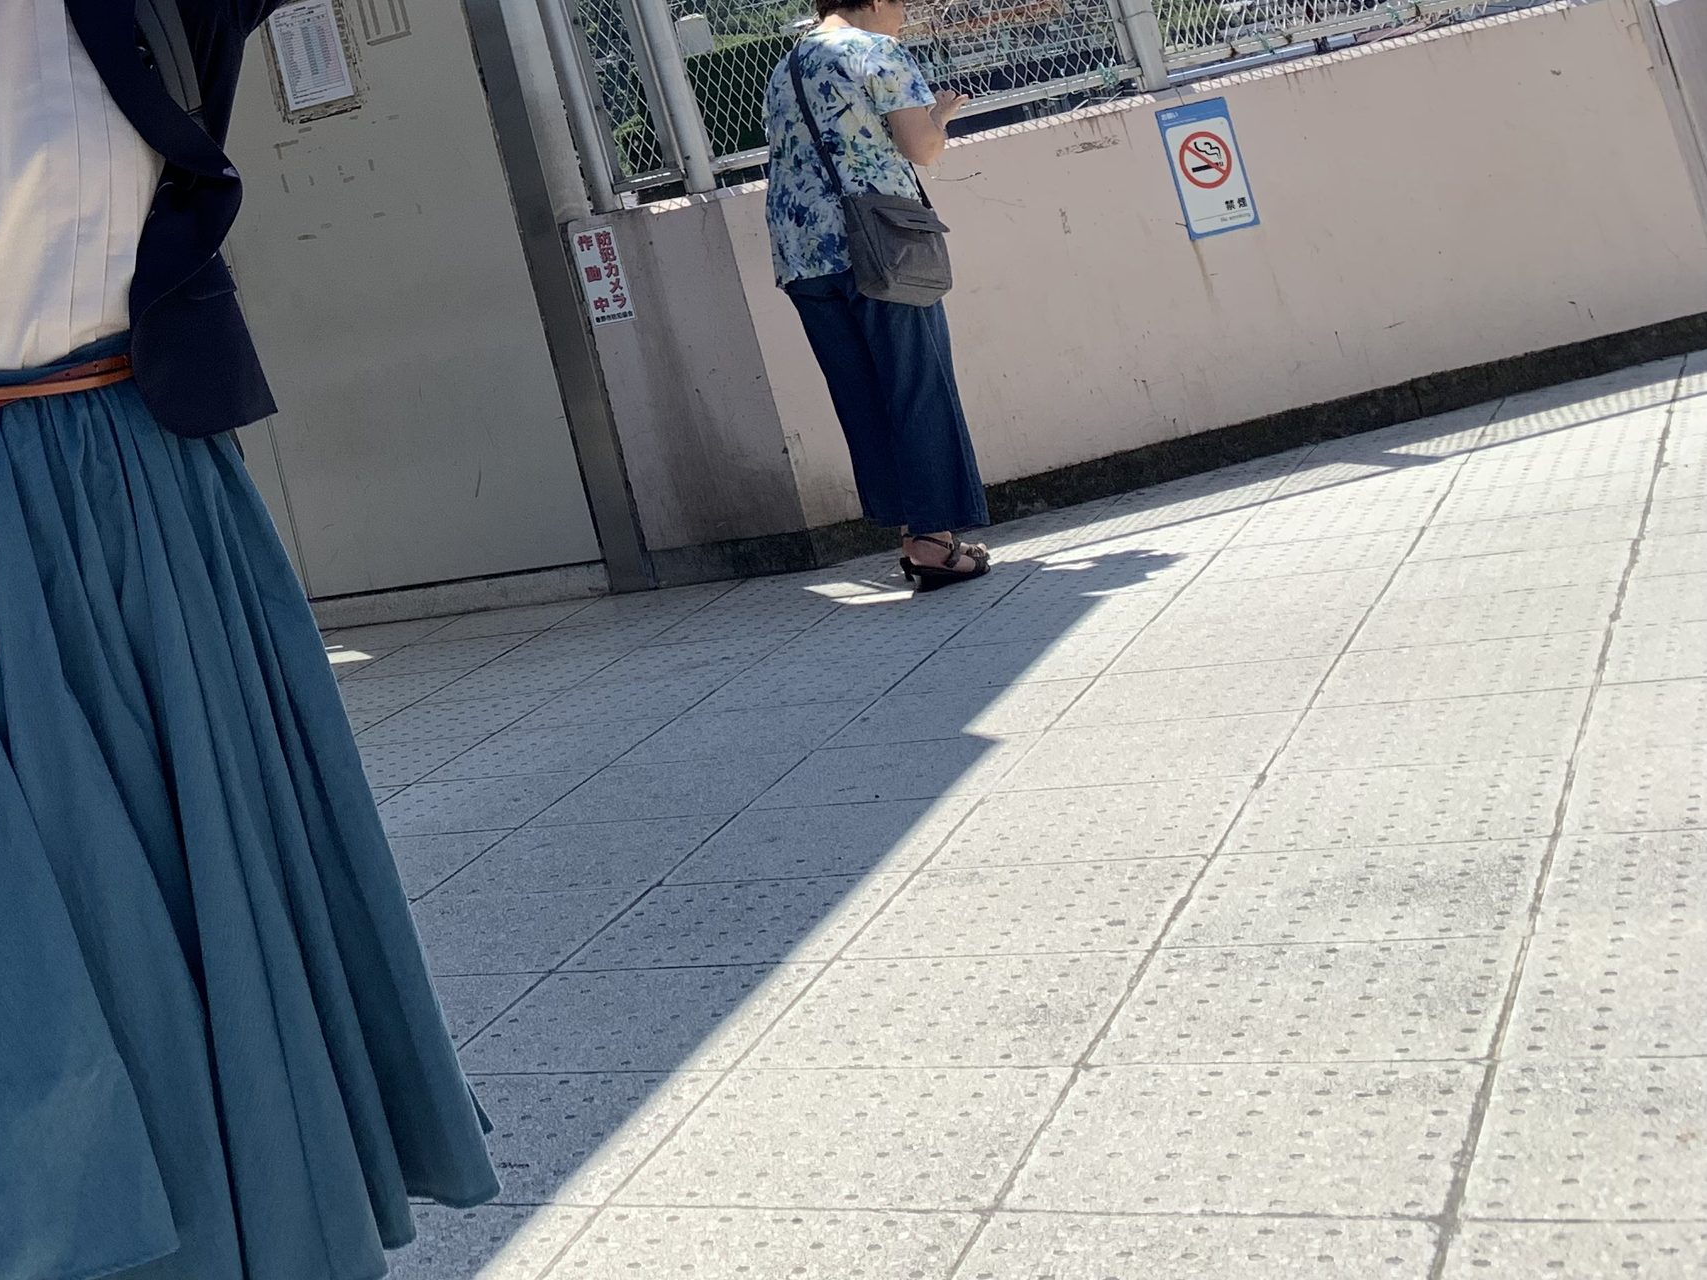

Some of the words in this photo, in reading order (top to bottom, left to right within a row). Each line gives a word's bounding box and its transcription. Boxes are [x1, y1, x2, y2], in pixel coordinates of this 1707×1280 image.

[1225, 196, 1248, 211] 禁煙
[1229, 212, 1251, 222] smoking
[577, 235, 610, 313] 作動中
[594, 230, 627, 309] 防犯カメラ
